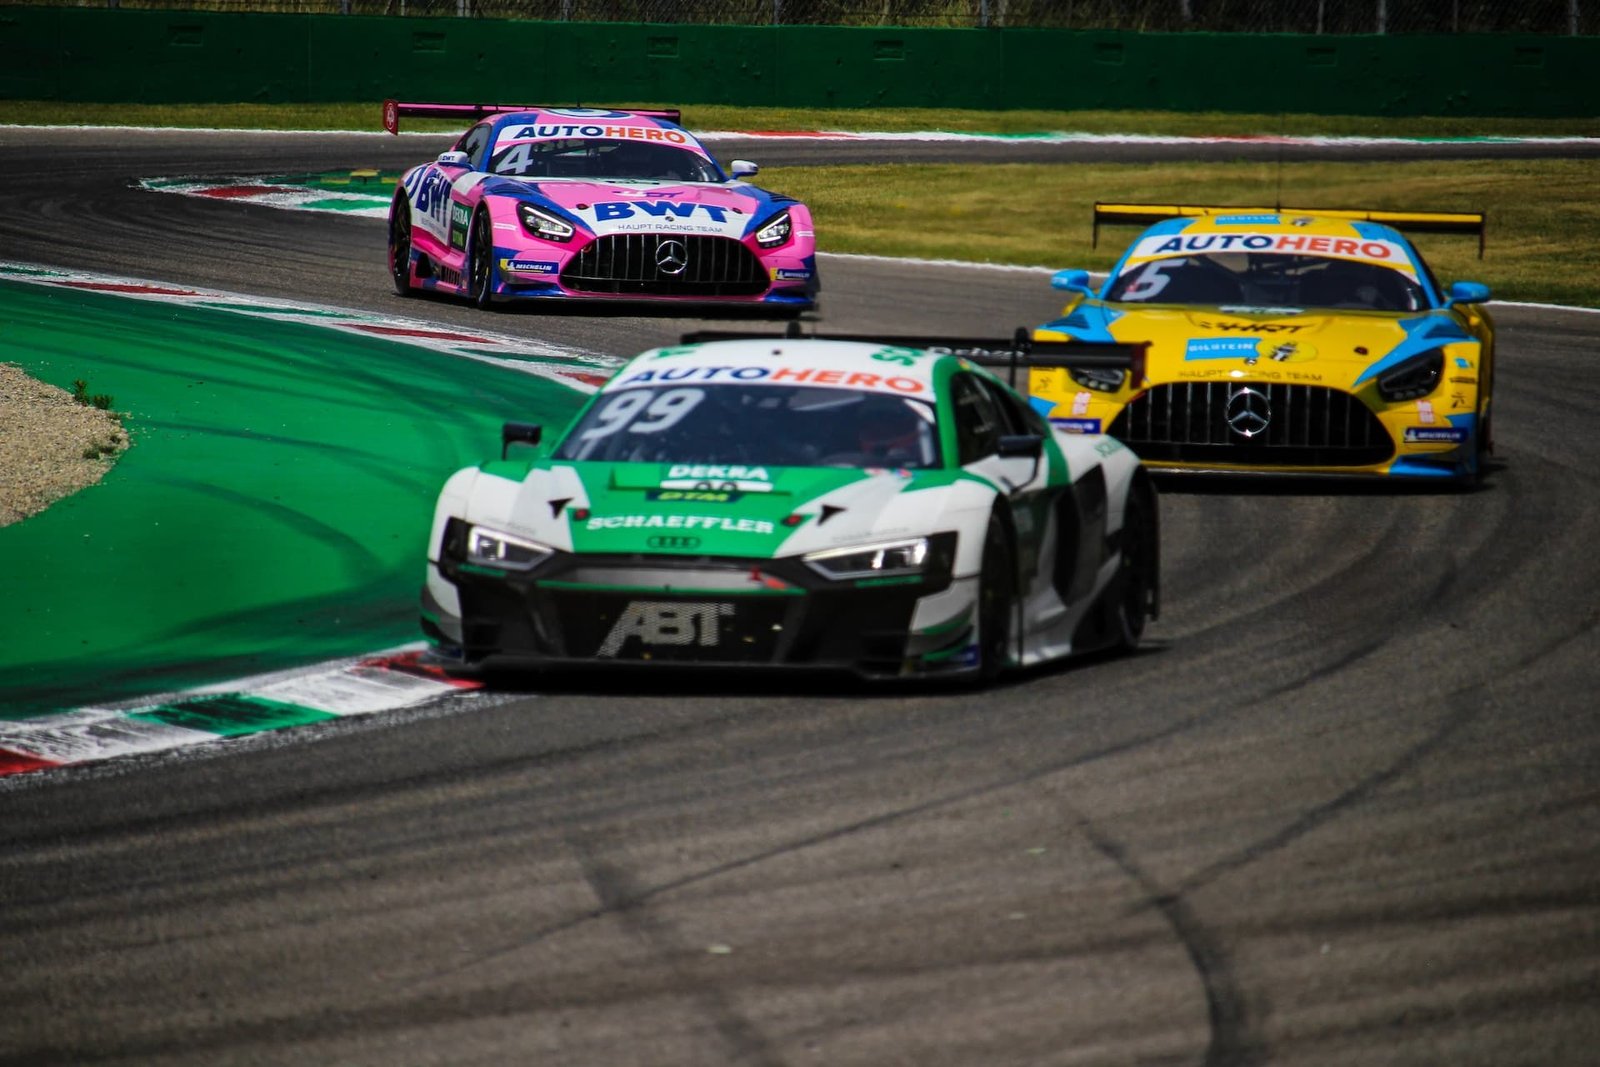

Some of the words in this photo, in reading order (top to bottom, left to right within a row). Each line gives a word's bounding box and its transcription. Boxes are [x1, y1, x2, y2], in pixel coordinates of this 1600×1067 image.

[513, 125, 686, 144] AUTOHERO
[495, 143, 534, 175] 4
[594, 200, 728, 223] BWT
[618, 223, 652, 231] HAUPT
[655, 223, 694, 232] RACING
[696, 225, 723, 233] TEAM
[1153, 234, 1391, 259] AUTOHERO
[1120, 258, 1188, 301] 5
[622, 366, 925, 393] AUTOHERO
[1286, 371, 1322, 381] TEAM
[581, 388, 705, 439] 99
[668, 464, 769, 481] DEKRA
[586, 514, 774, 534] SCHAEFFLER
[596, 601, 735, 658] ABT
